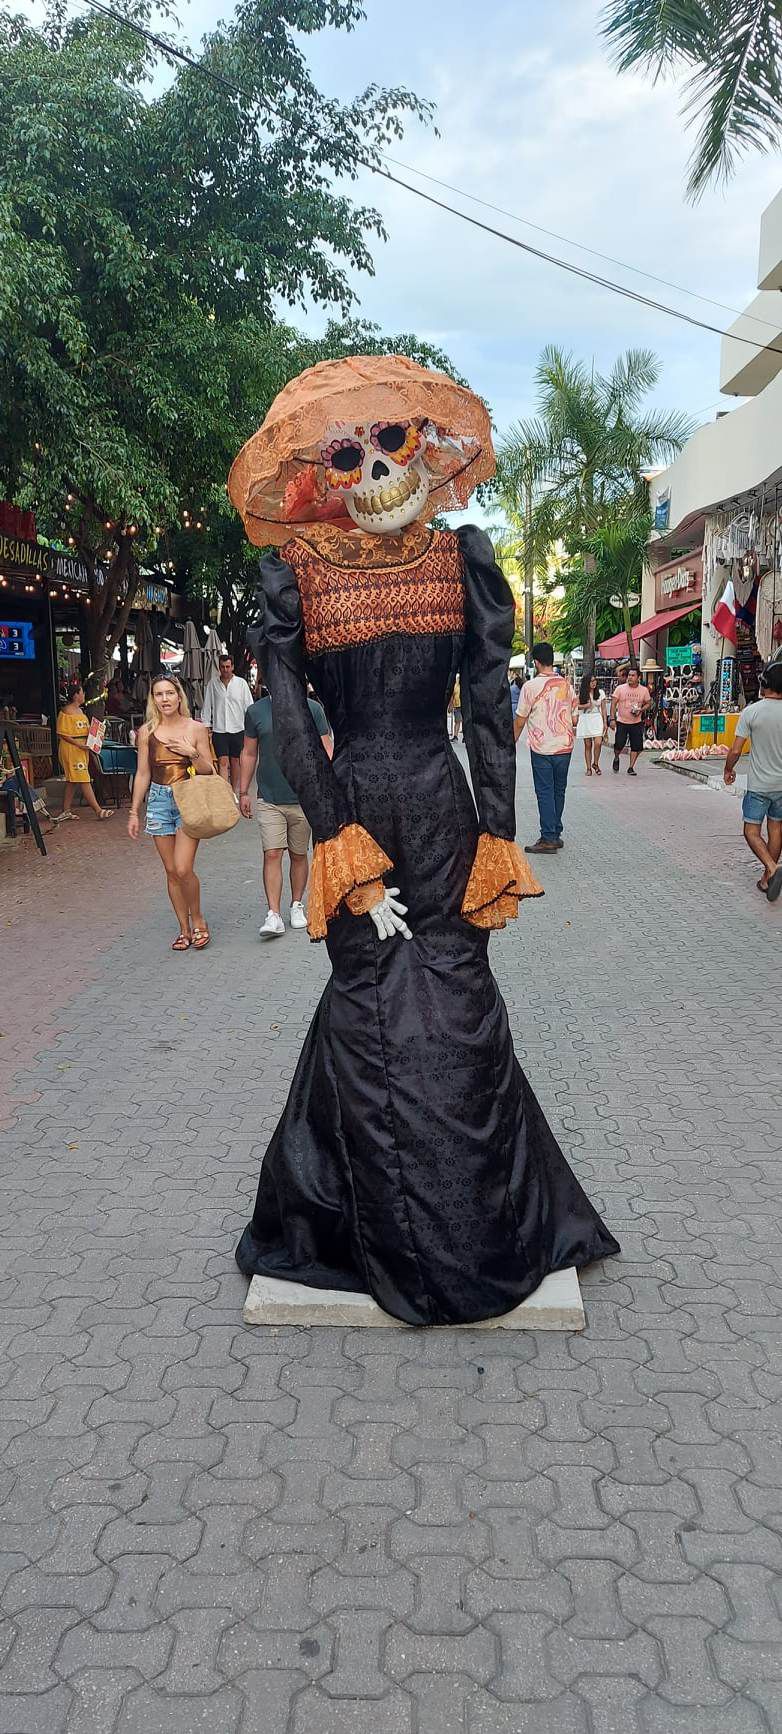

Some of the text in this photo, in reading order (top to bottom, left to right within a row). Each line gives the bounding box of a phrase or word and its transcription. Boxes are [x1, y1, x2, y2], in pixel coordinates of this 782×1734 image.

[56, 557, 88, 583] MEXICAN
[12, 629, 18, 638] 3
[13, 642, 19, 651] 3
